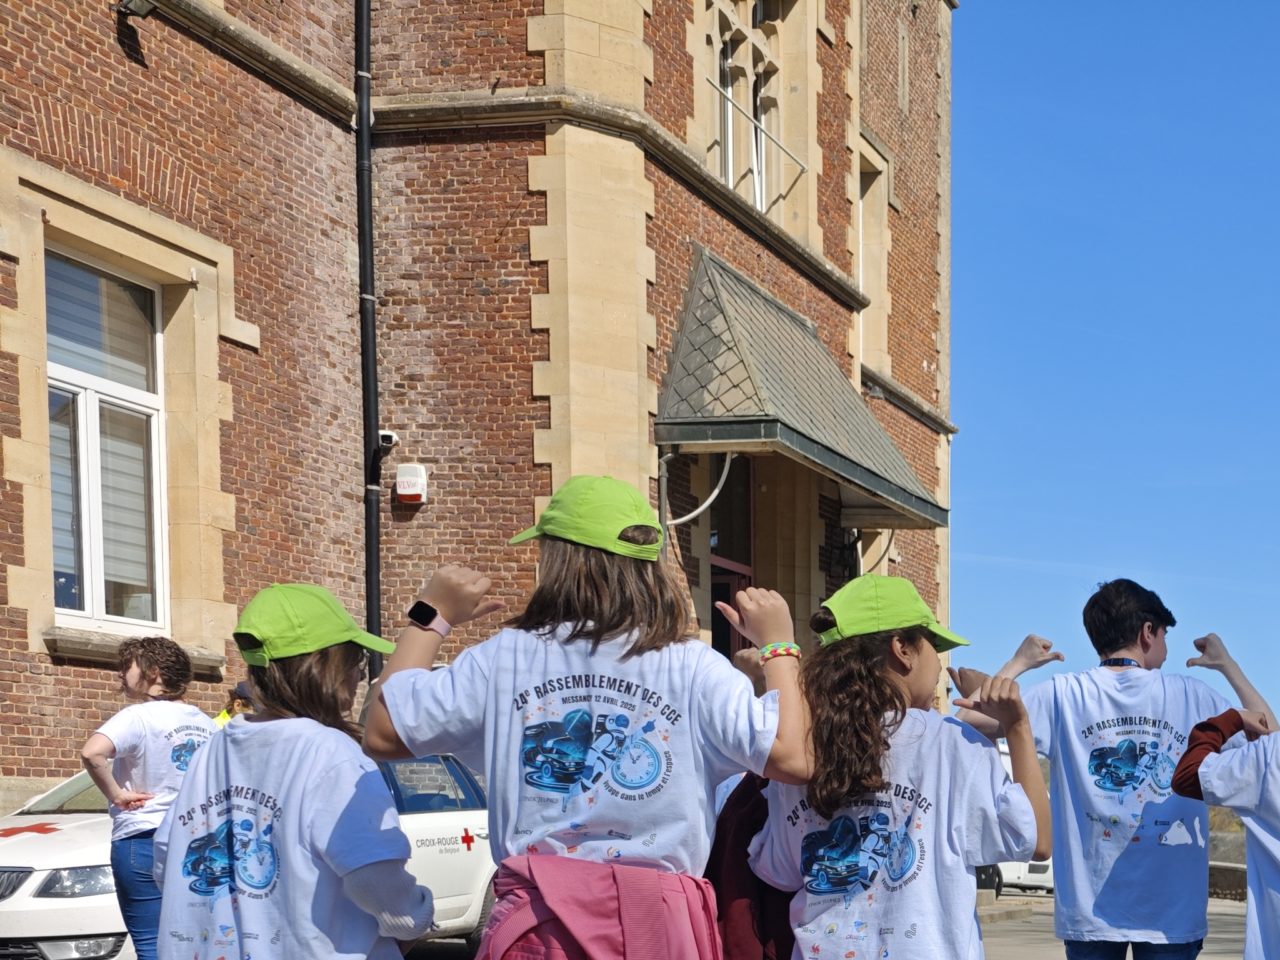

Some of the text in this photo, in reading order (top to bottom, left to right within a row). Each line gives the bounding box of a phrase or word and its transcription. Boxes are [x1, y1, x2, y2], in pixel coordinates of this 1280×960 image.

[514, 674, 682, 726] 24e RASSEMBLEMENT DES CCE
[603, 696, 618, 706] AVRIL
[620, 700, 636, 712] 2025
[1081, 725, 1094, 739] 24e
[1096, 716, 1161, 732] RASSEMBLEMENT
[1173, 731, 1187, 745] CCE
[620, 793, 636, 801] dans
[645, 783, 664, 798] temps
[893, 784, 916, 802] DES
[179, 808, 196, 826] 24e
[260, 792, 278, 811] DES
[876, 800, 892, 808] 2025
[416, 836, 459, 848] CROIX-ROUGE
